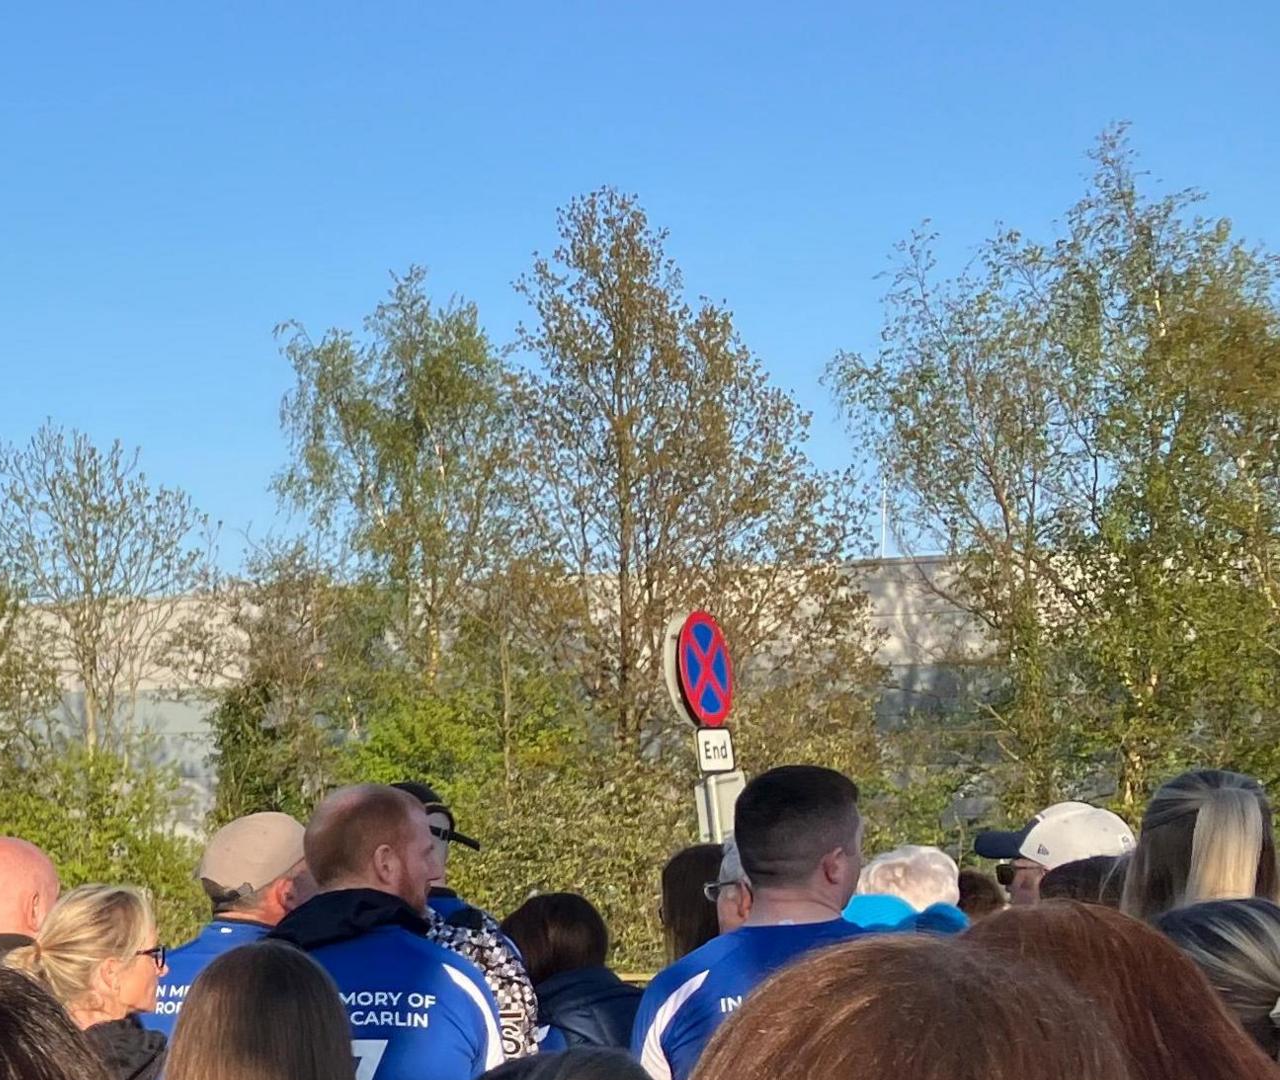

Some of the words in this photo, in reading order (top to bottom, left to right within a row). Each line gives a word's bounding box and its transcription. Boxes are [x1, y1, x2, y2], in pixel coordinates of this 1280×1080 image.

[704, 741, 728, 759] End
[407, 993, 437, 1009] OF
[721, 995, 742, 1012] IN
[350, 1010, 428, 1028] CARLIN
